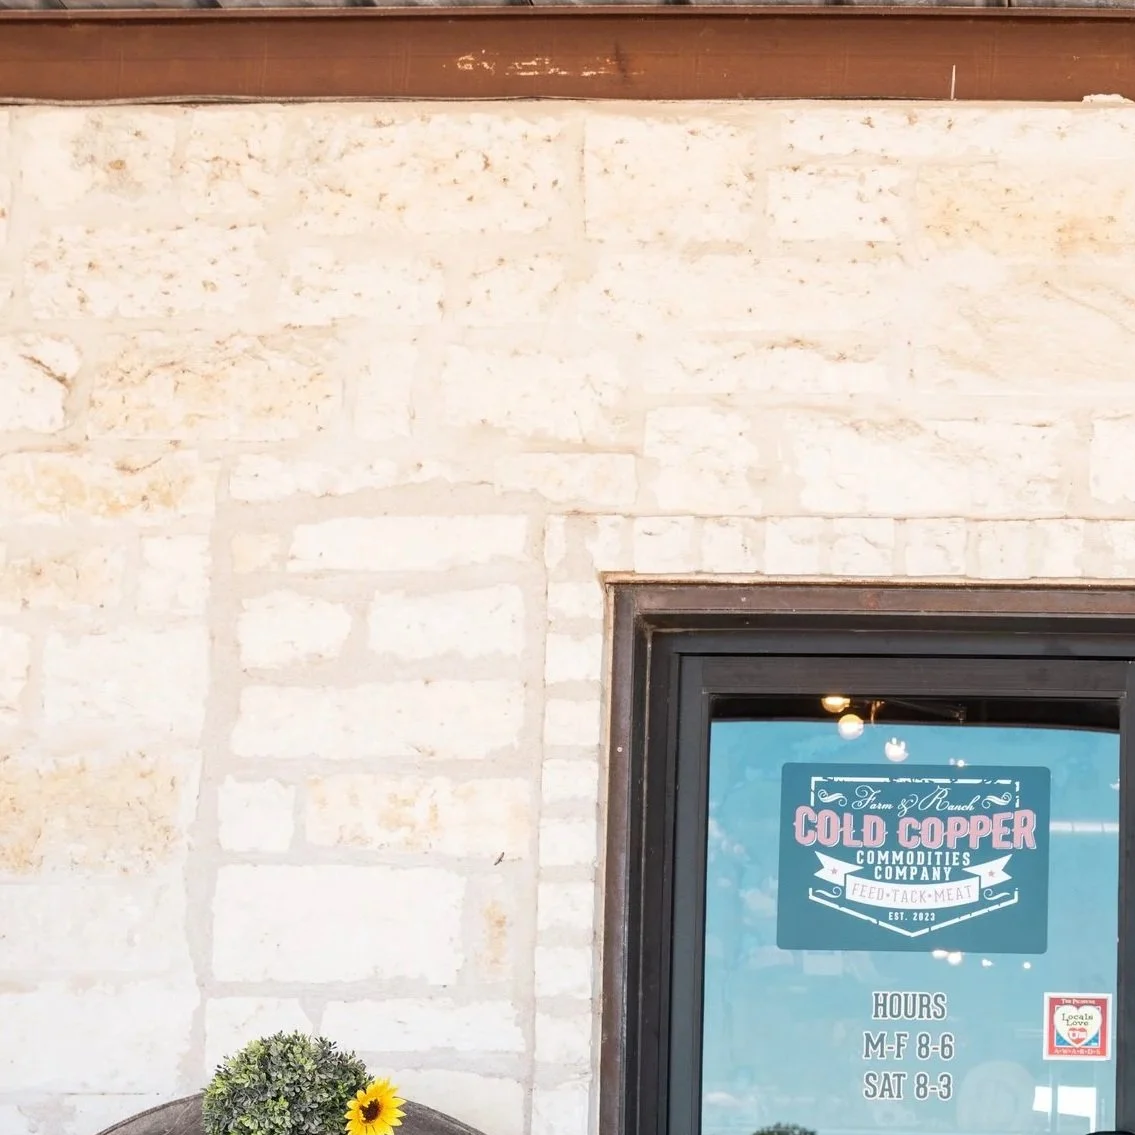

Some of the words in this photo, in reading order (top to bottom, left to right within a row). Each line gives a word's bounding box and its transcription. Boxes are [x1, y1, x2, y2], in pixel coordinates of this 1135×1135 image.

[851, 785, 894, 811] Farm
[897, 794, 919, 817] &
[918, 785, 981, 811] Ranch
[793, 805, 888, 848] COLD
[897, 809, 1037, 850] COPPER
[856, 850, 971, 866] COMMODITIES
[874, 866, 953, 881] COMPANY
[888, 911, 908, 921] EST.
[913, 912, 936, 922] 2023
[872, 991, 948, 1020] HOURS
[1062, 1013, 1094, 1021] Locals
[863, 1032, 909, 1060] M-F
[916, 1032, 955, 1061] 8-6
[863, 1072, 907, 1100] SAT
[914, 1072, 953, 1101] 8-3
